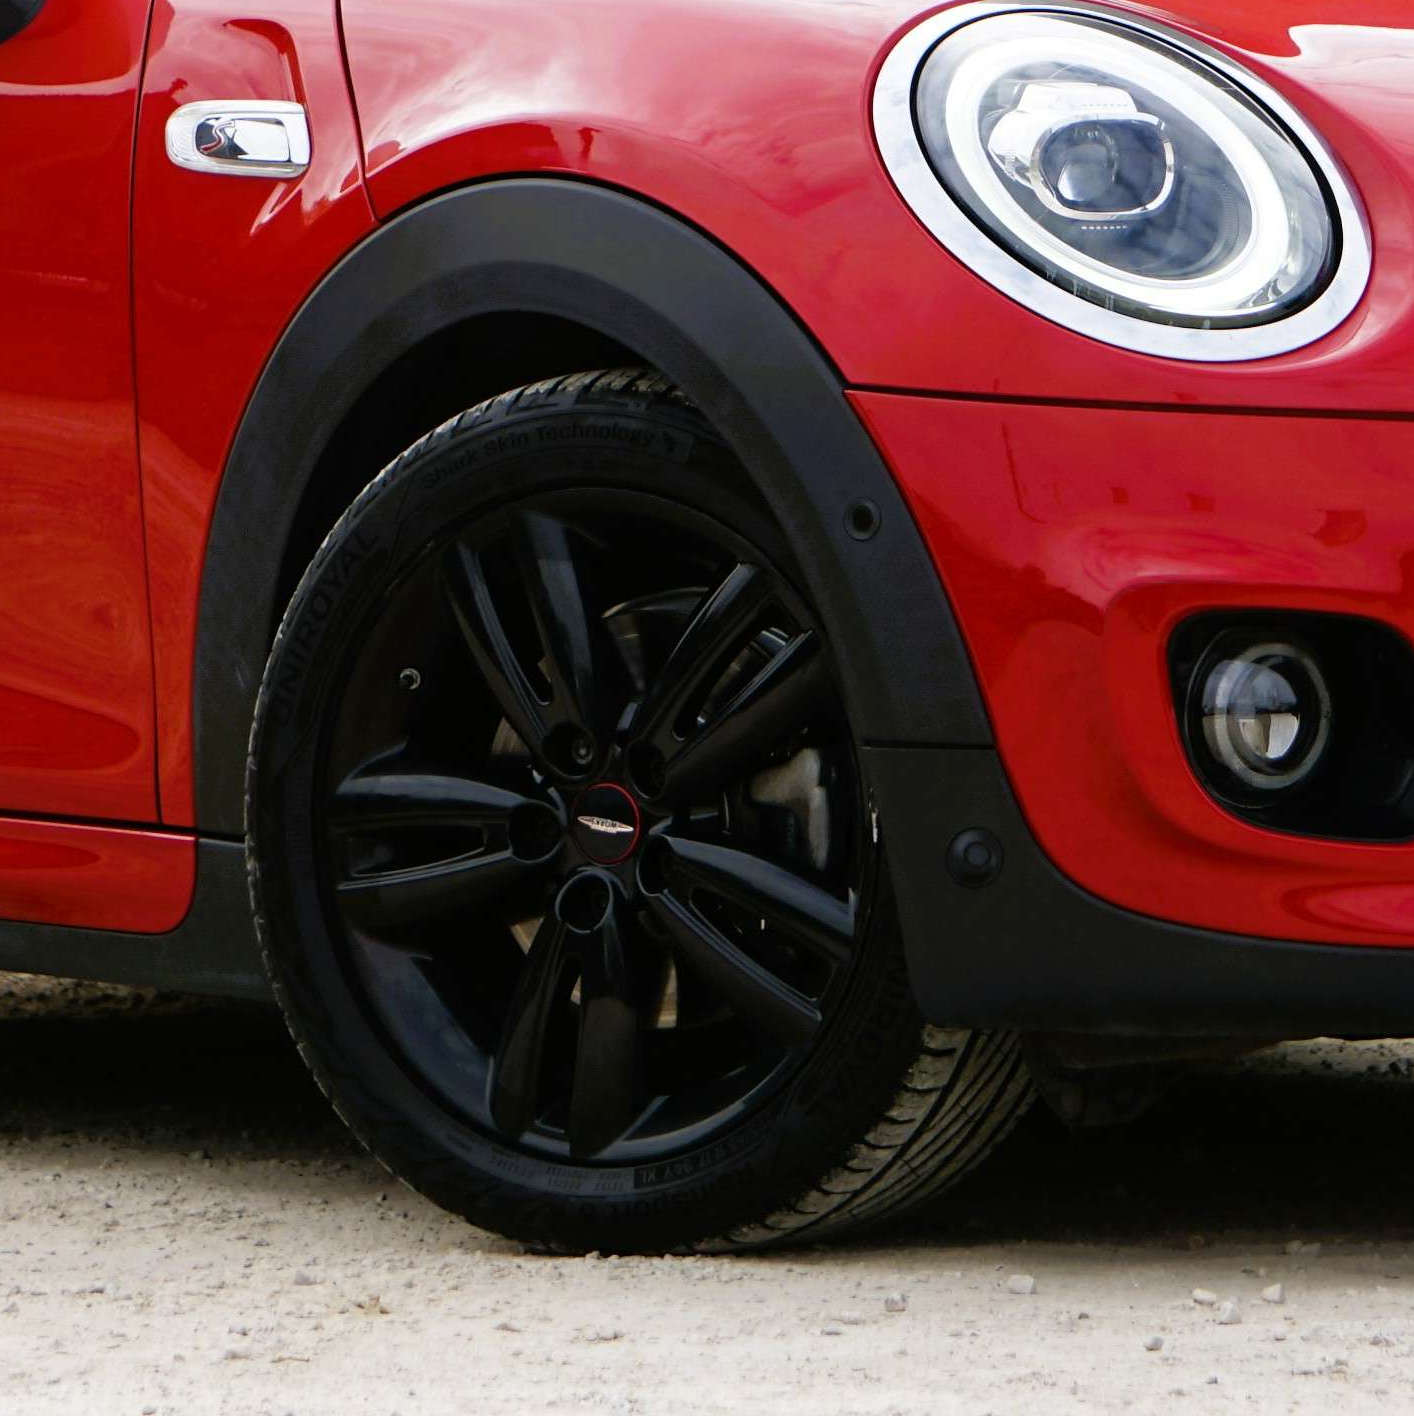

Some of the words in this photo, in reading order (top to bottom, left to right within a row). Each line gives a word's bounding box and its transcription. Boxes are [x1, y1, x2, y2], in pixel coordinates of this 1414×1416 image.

[484, 431, 529, 456] Skin
[535, 422, 656, 449] Technology
[268, 530, 380, 727] UNIROYAL
